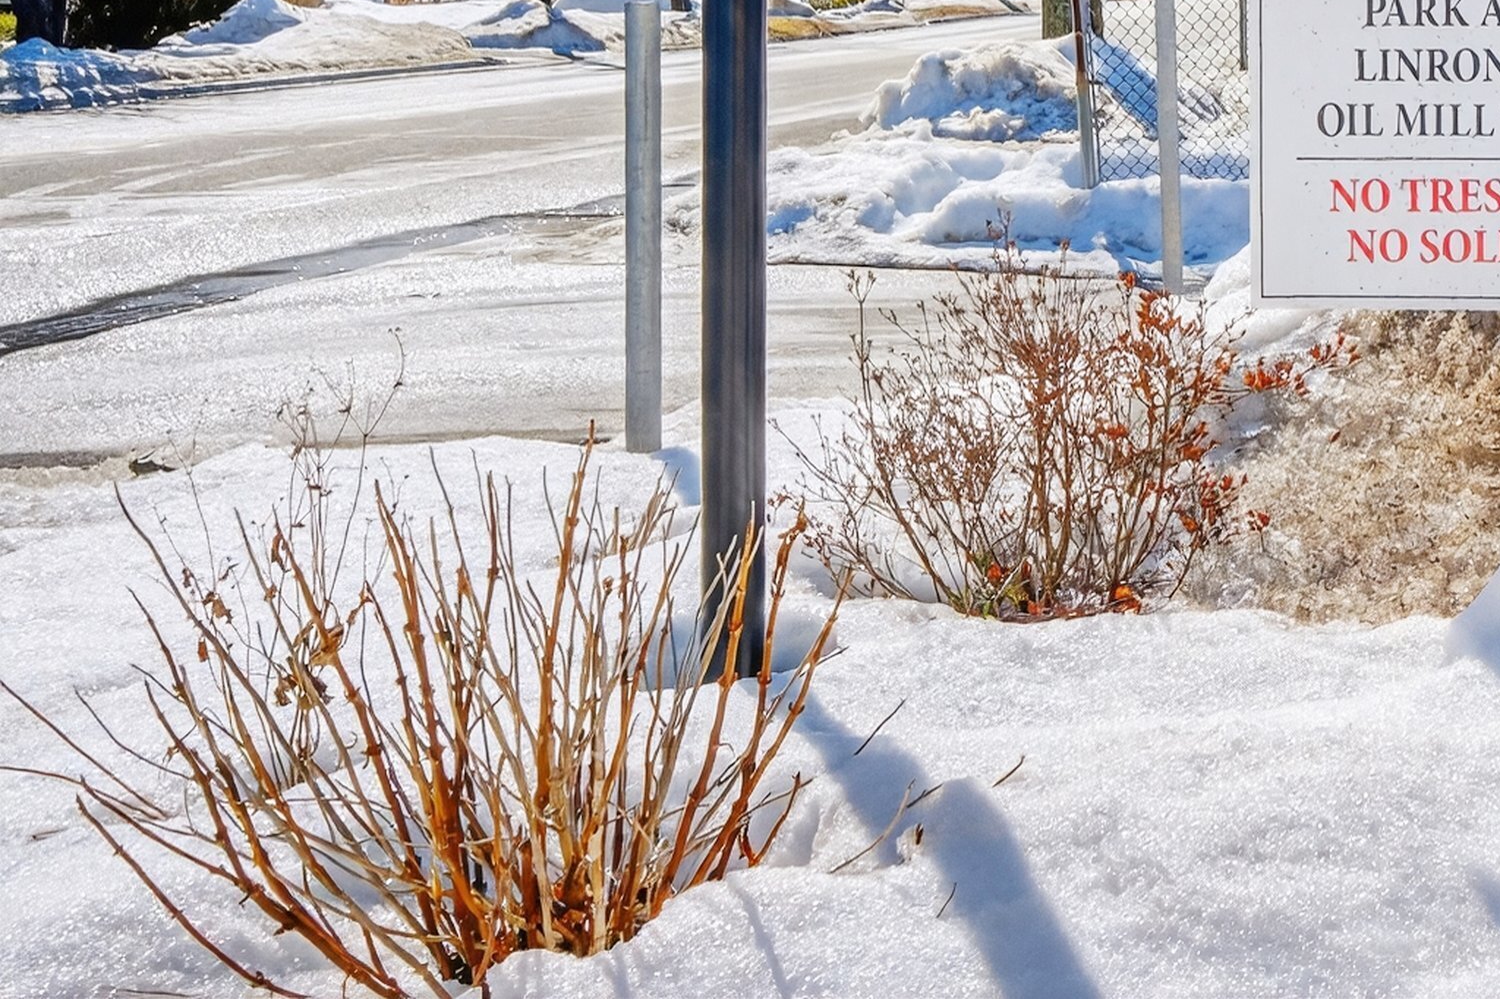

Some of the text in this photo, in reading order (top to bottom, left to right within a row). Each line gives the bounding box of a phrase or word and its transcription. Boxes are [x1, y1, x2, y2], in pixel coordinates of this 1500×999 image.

[1316, 102, 1382, 138] OIL
[1394, 103, 1493, 137] MILL
[1329, 179, 1391, 212] NO
[1347, 229, 1408, 263] NO
